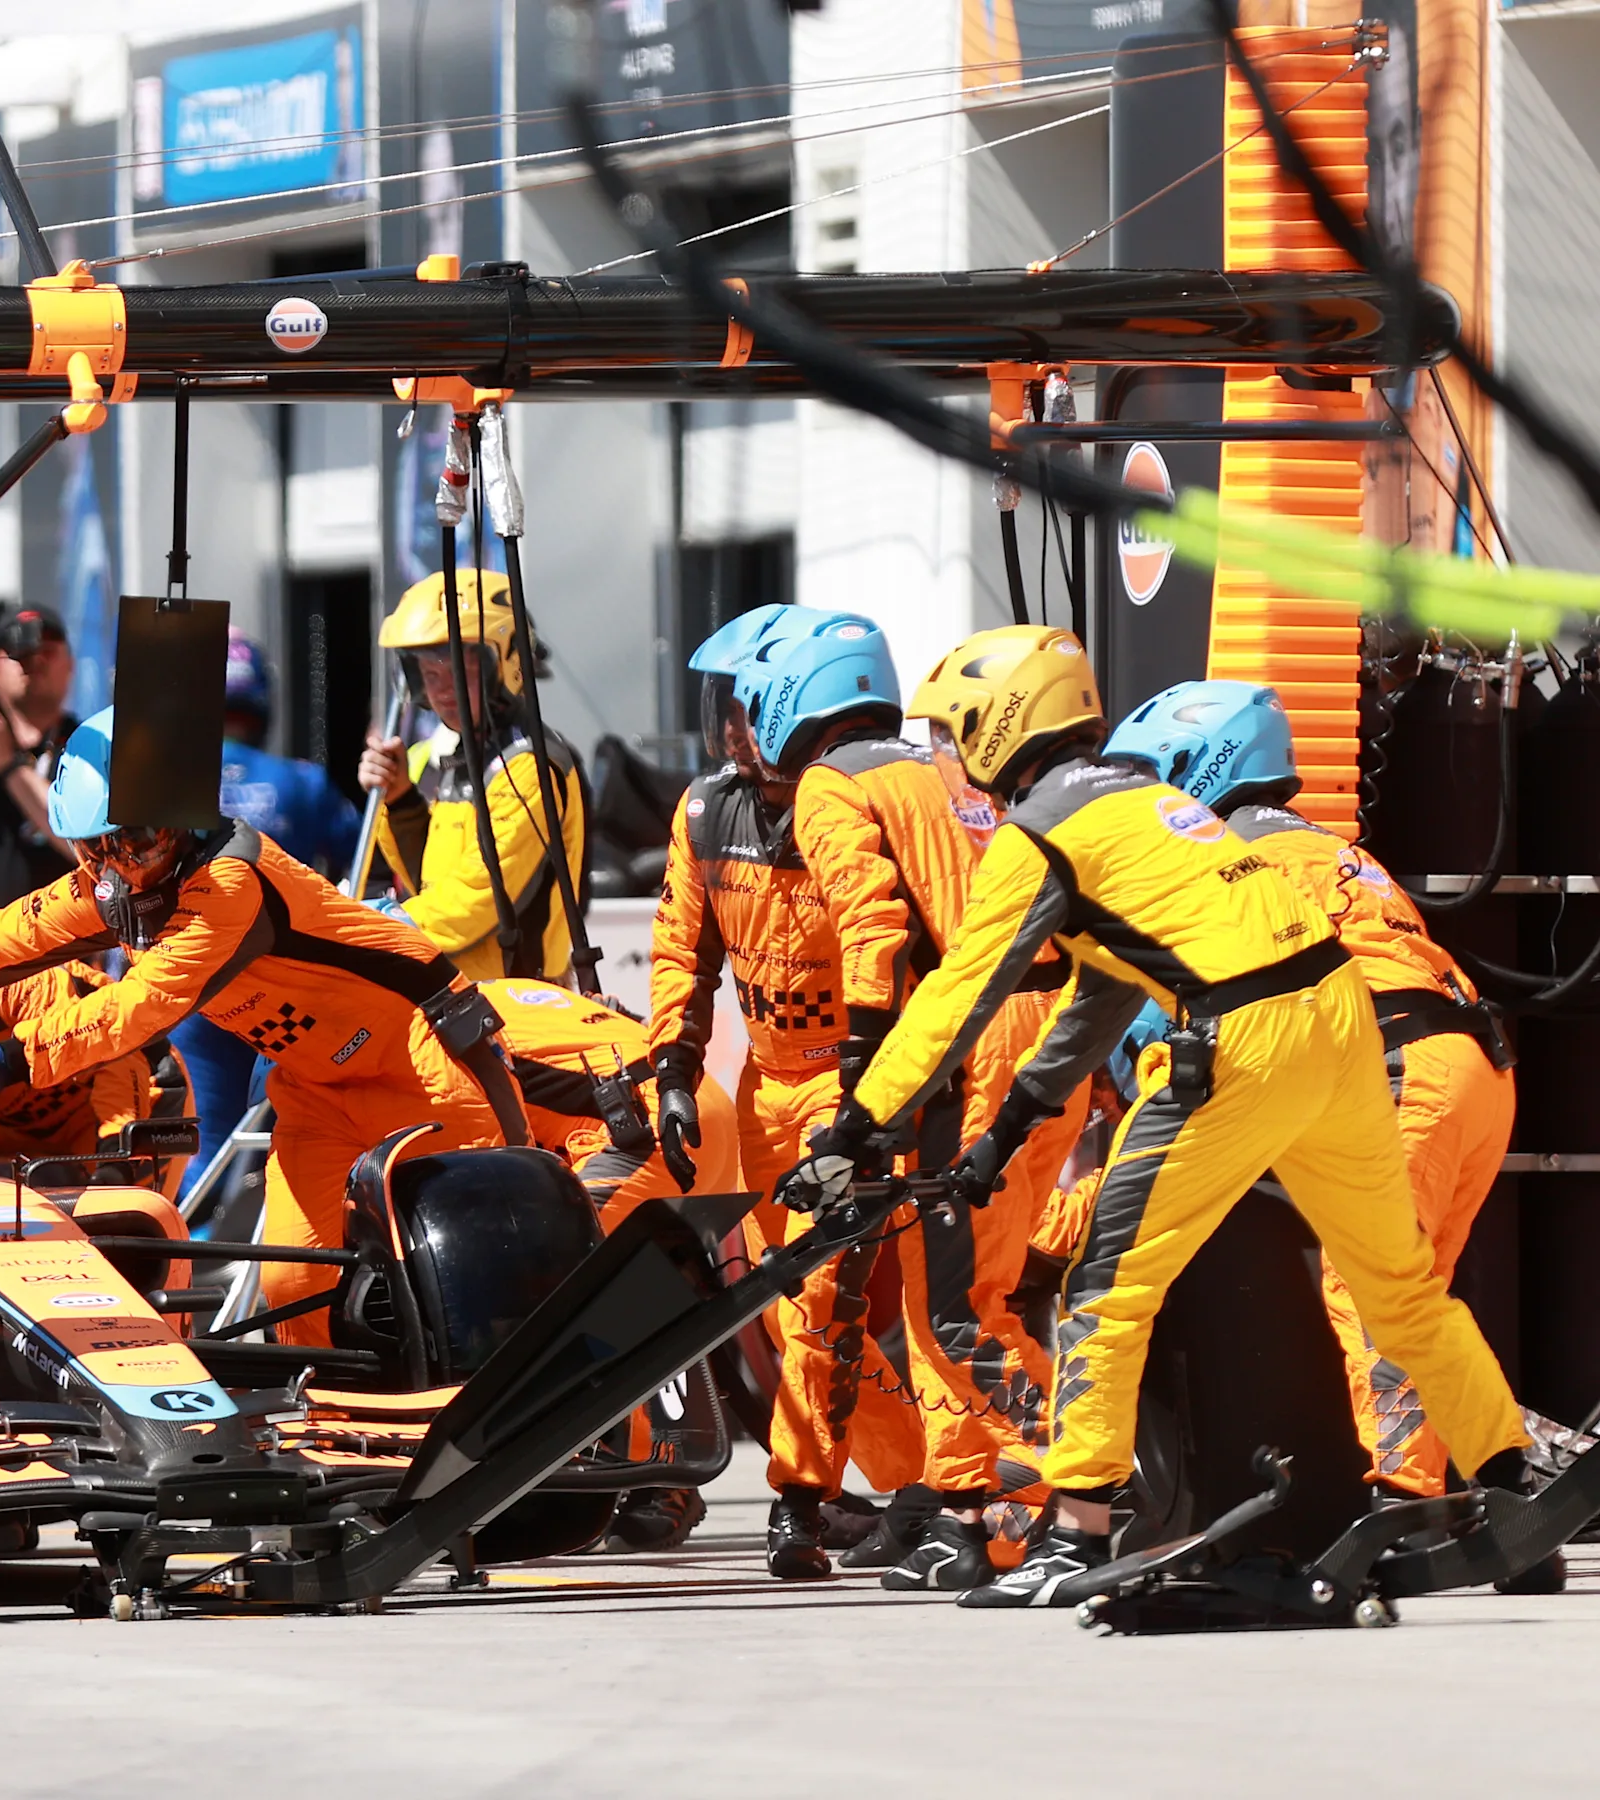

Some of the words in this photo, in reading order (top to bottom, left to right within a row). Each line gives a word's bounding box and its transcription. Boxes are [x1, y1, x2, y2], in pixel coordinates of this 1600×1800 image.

[270, 317, 323, 334] Gulf
[765, 674, 800, 750] easypost.
[980, 689, 1029, 769] easypost.
[1189, 738, 1243, 799] asypost.
[1168, 805, 1213, 831] Gulf
[753, 949, 832, 973] Technologies
[332, 1029, 369, 1064] sparco
[804, 1045, 840, 1060] sparc
[151, 1132, 192, 1144] Medallia
[0, 1258, 88, 1268] alteryx
[20, 1273, 99, 1283] DELL
[73, 1324, 151, 1333] DataRobot
[90, 1339, 168, 1350] OKX
[12, 1332, 70, 1390] McLaren
[163, 1393, 215, 1411] K
